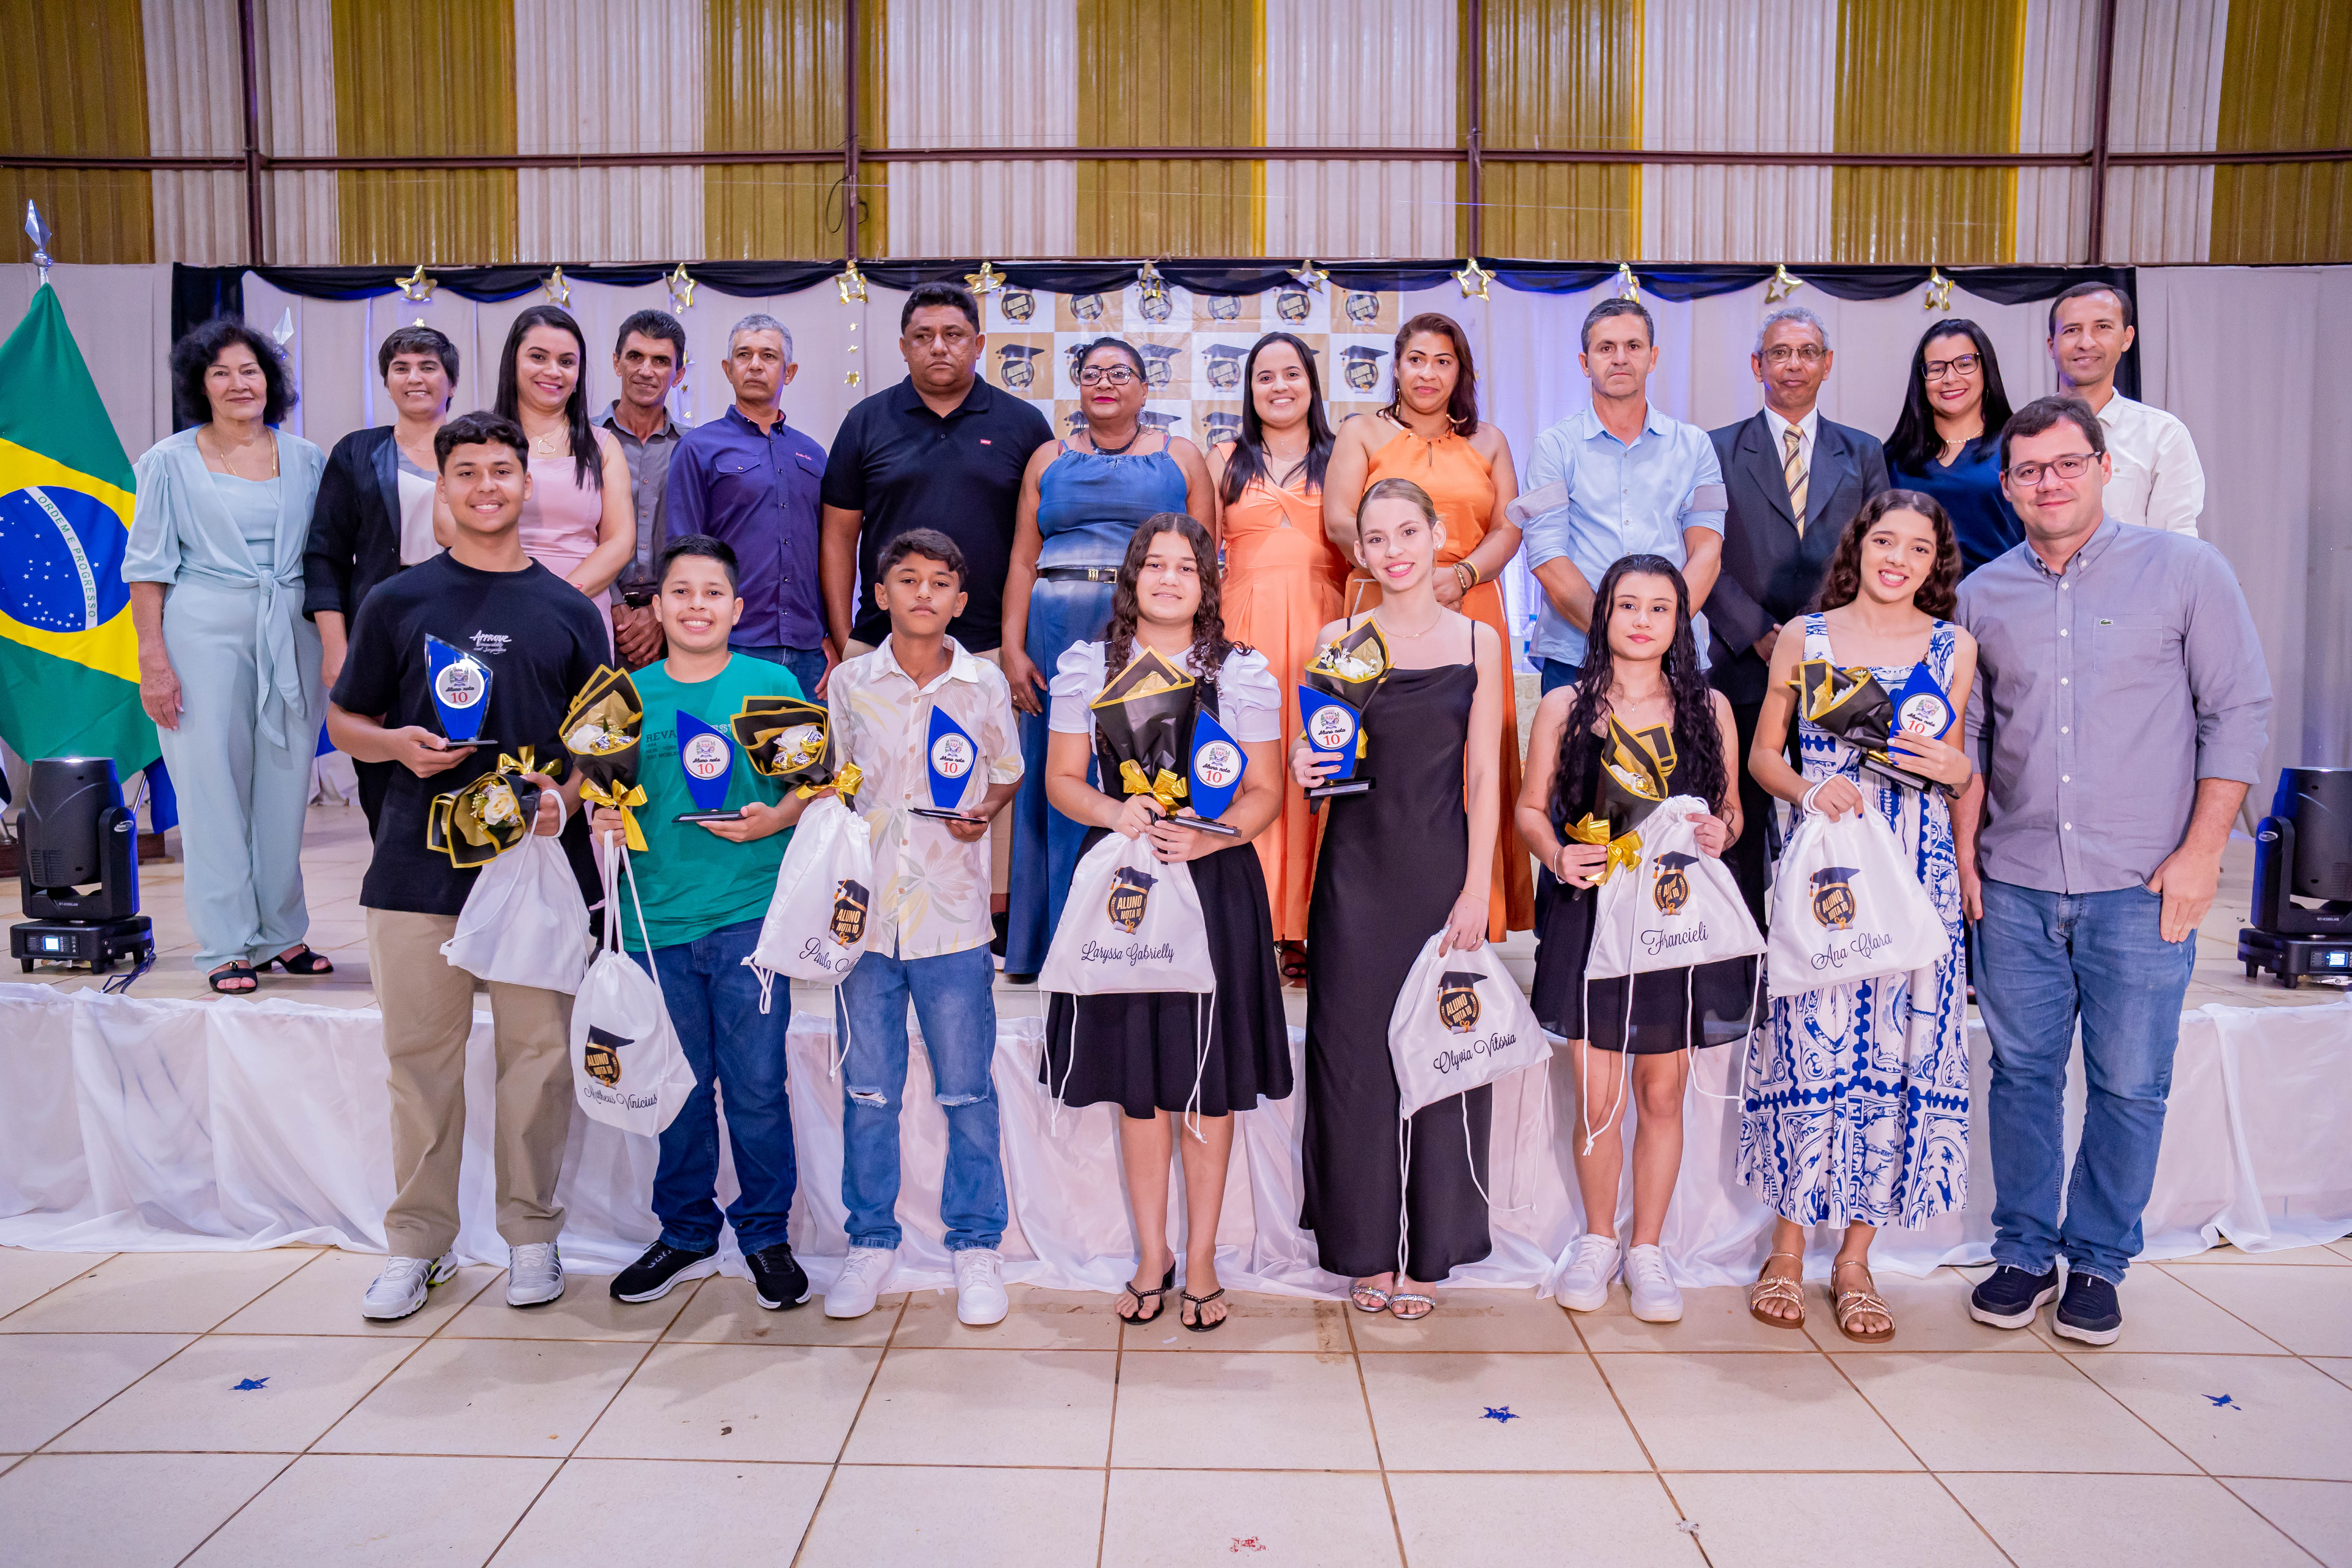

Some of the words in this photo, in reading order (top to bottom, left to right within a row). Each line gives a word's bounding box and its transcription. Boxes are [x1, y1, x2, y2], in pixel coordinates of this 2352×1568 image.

[38, 496, 70, 533] ORDEM
[73, 548, 96, 617] PROGRESSO
[451, 692, 468, 703] 10
[1908, 720, 1925, 733] 10
[1323, 734, 1340, 746] 10
[697, 763, 714, 774] 10
[943, 762, 958, 773] 10
[1206, 770, 1222, 783] 10
[1116, 895, 1143, 910] ALUNO
[1822, 889, 1844, 913] ALUNO
[836, 909, 861, 924] ALUNO
[1120, 909, 1136, 920] NOTA
[1136, 908, 1142, 917] 10
[1828, 905, 1843, 921] NOTA
[1840, 901, 1849, 913] 10
[836, 922, 851, 933] NOTA
[852, 924, 859, 934] 10
[1641, 921, 1709, 955] Francieli
[799, 937, 831, 970] Paulo
[1081, 940, 1123, 964] Laryssa
[1126, 943, 1175, 966] Gabrielly
[1811, 943, 1848, 970] Ana
[1850, 933, 1893, 959] Clara
[1446, 993, 1468, 1016] ALUNO
[1453, 1009, 1467, 1024] NOTA
[1465, 1005, 1472, 1016] 10
[586, 1053, 609, 1067] ALUNO
[1433, 1049, 1473, 1074] Olyvia
[1474, 1033, 1516, 1058] Vitória
